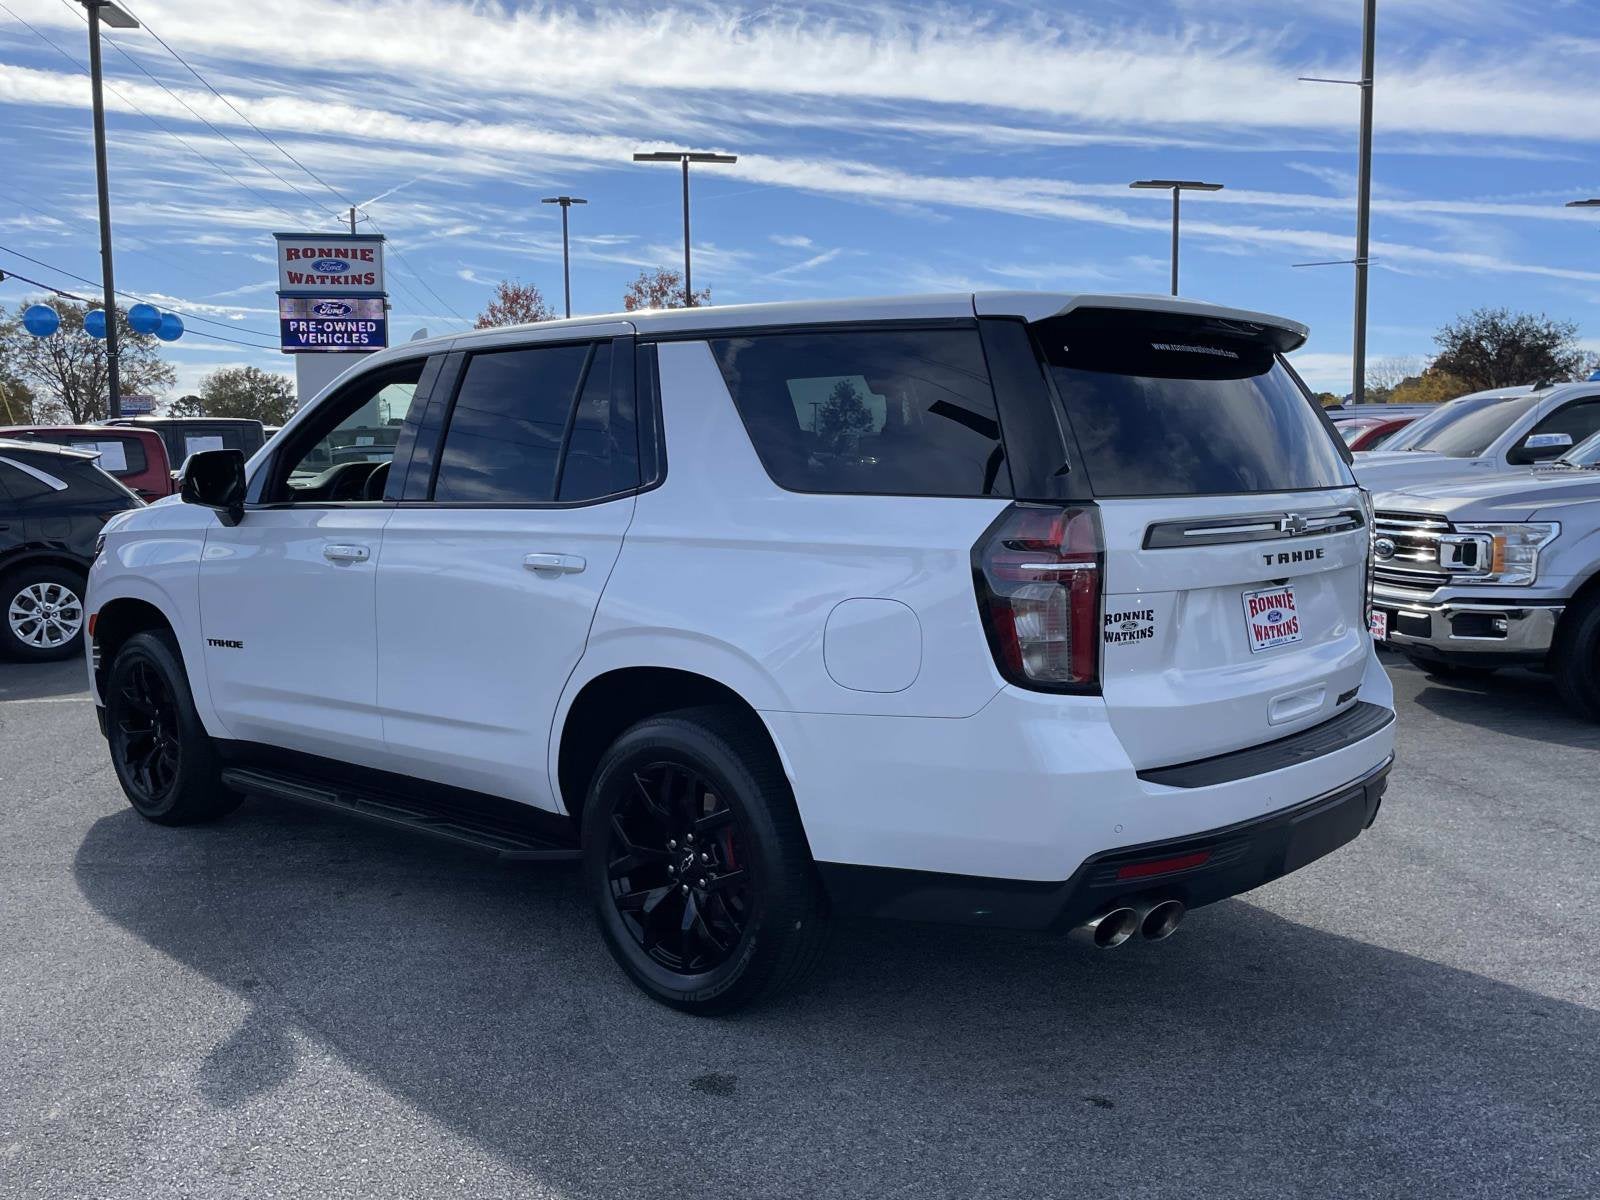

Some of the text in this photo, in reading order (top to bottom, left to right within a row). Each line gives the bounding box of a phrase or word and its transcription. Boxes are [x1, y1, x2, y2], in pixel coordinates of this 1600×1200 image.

[286, 248, 374, 262] RONNIE
[319, 261, 343, 271] Ford
[287, 271, 375, 285] WATKINS
[319, 302, 345, 315] Ford
[289, 321, 377, 332] PRE-OWNED
[298, 333, 369, 344] VEHICLES
[1262, 548, 1325, 566] TAHOE
[1248, 592, 1296, 619] RONNIE
[1104, 609, 1154, 626] RONNIE
[1104, 625, 1154, 643] WATKINS
[1252, 615, 1299, 642] WATKINS
[206, 638, 244, 649] TAHOE
